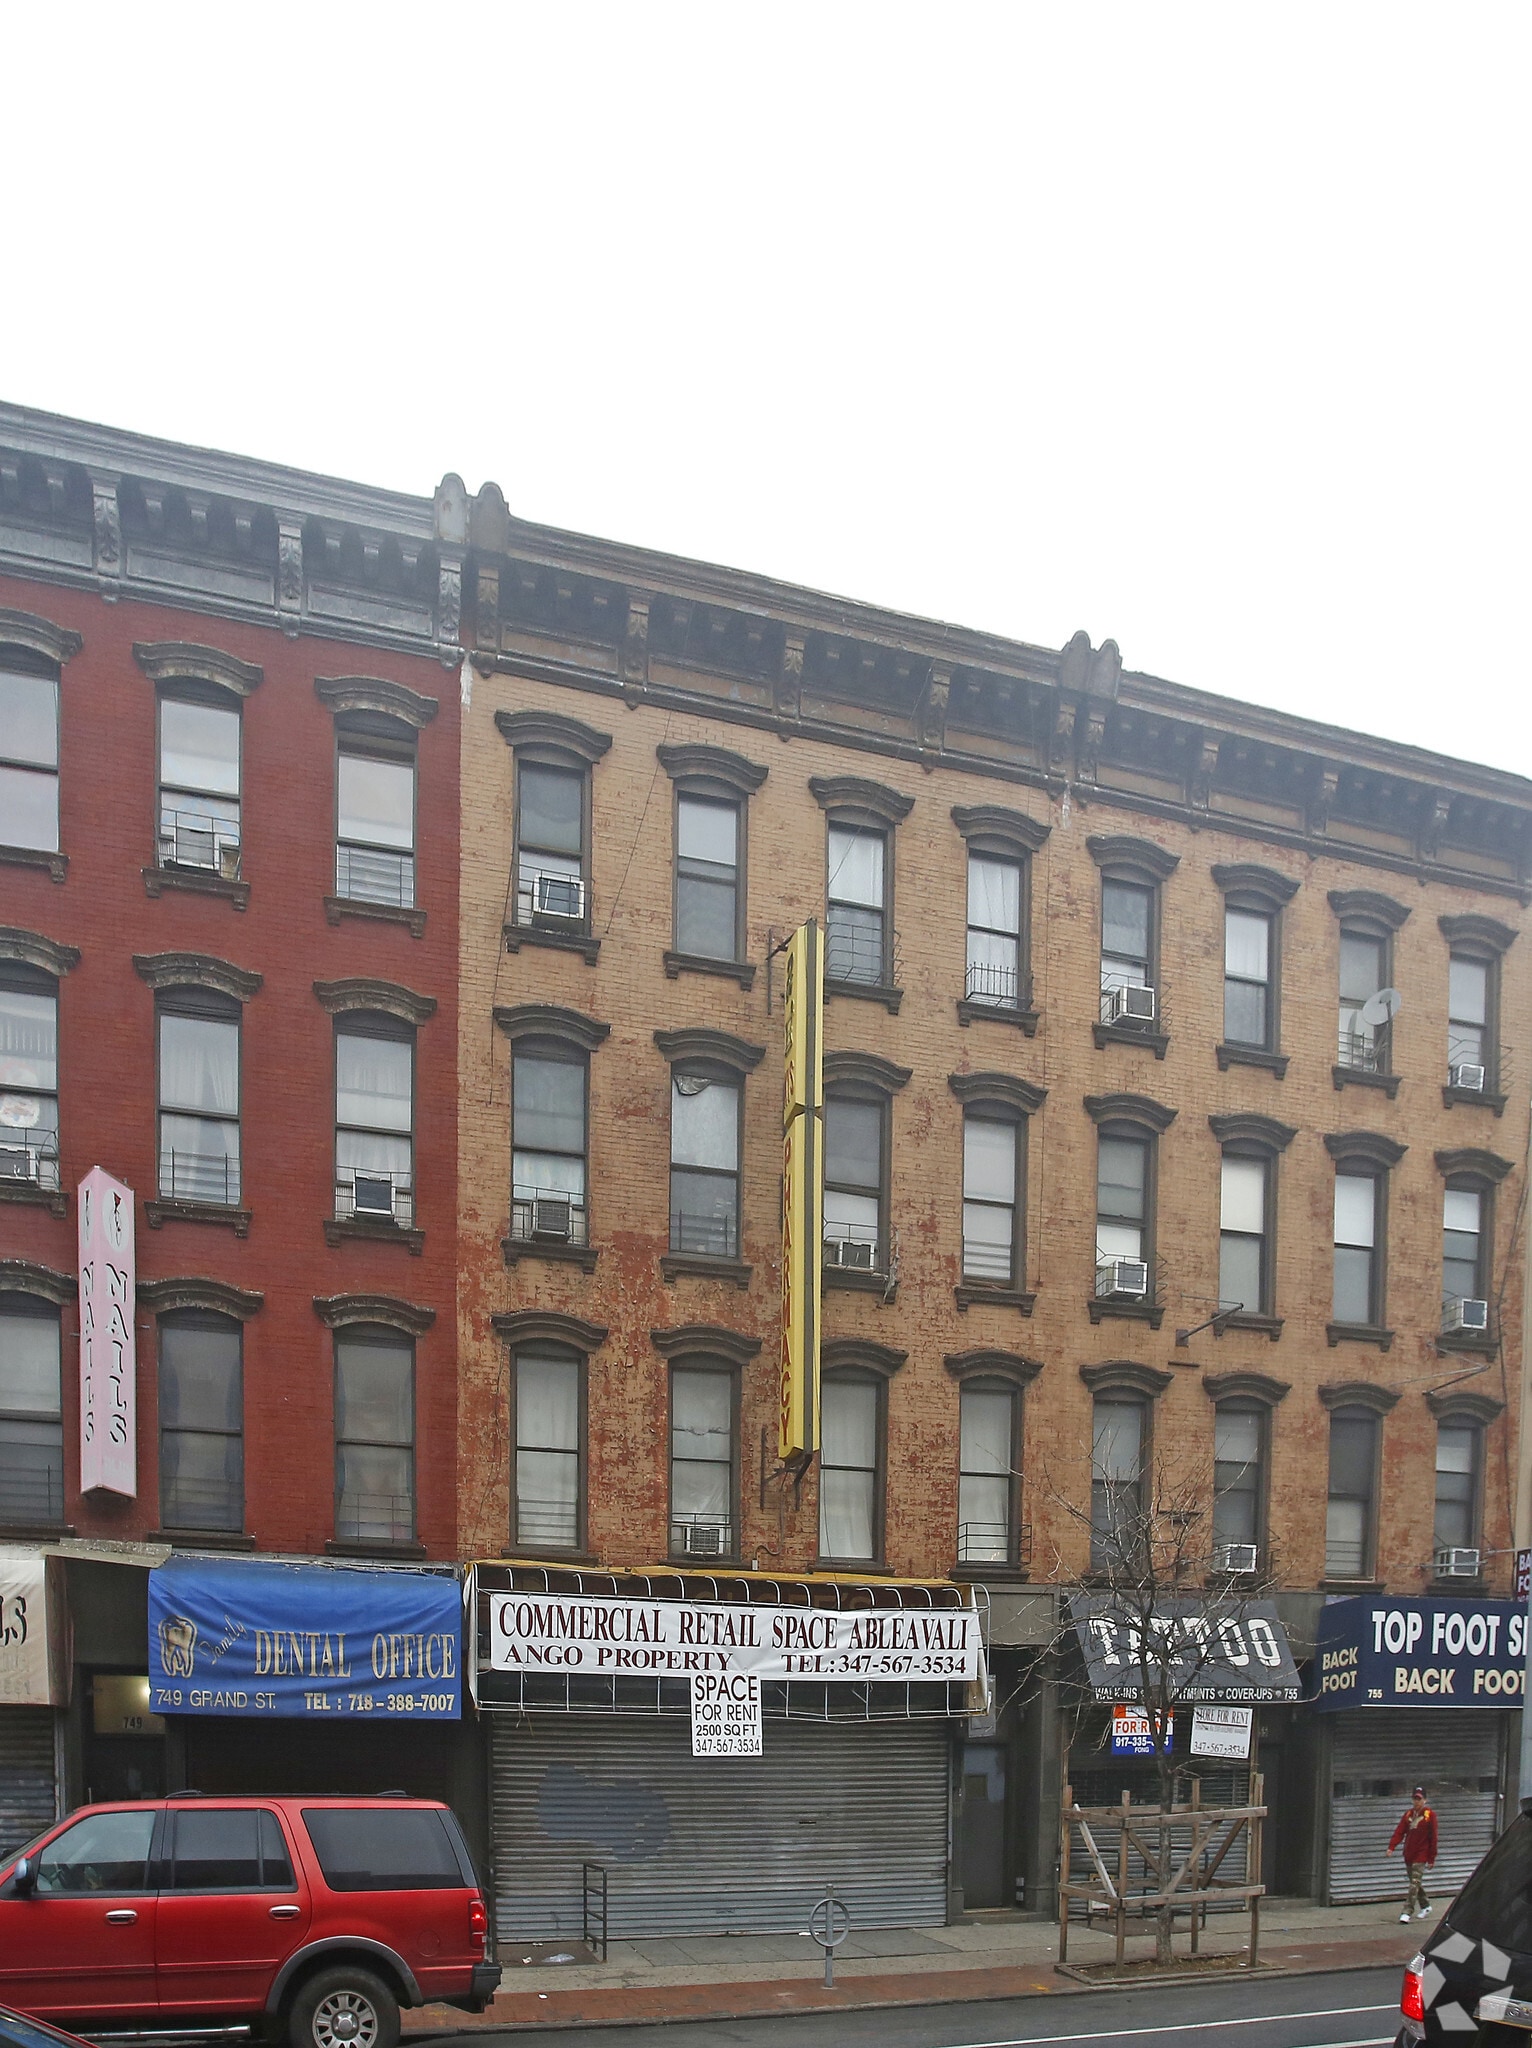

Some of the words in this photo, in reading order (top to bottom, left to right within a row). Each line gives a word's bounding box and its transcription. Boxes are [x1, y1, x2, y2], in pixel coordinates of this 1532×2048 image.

[781, 1136, 792, 1446] PHARMACY
[105, 1262, 129, 1443] NAILS
[499, 1602, 667, 1643] COMMERCIAL
[679, 1610, 761, 1647] RETAIL
[772, 1615, 837, 1649] SPACE
[848, 1617, 968, 1650] ABLEAVALI
[1372, 1610, 1423, 1654] TOP
[1431, 1612, 1500, 1656] FOOT
[199, 1614, 247, 1665] Family
[254, 1630, 351, 1678] DENTAL
[371, 1633, 456, 1679] OFFICE
[504, 1644, 583, 1665] ANGO
[597, 1648, 733, 1671] PROPERTY
[1322, 1647, 1358, 1670] BACK
[695, 1675, 757, 1701] SPACE
[1322, 1671, 1357, 1693] FOOT
[1394, 1667, 1455, 1694] BACK
[156, 1689, 182, 1706] 749
[190, 1690, 248, 1708] GRAND
[255, 1693, 276, 1709] ST.
[1226, 1688, 1272, 1700] COVER-UPS
[1285, 1688, 1298, 1700] 755
[1368, 1689, 1382, 1699] 755
[124, 1717, 142, 1729] 749
[695, 1704, 721, 1721] FOR
[727, 1704, 757, 1721] RENT
[1217, 1709, 1229, 1722] FOR
[1232, 1711, 1249, 1724] RENT
[696, 1724, 721, 1736] 2500
[724, 1724, 741, 1736] SQ
[1116, 1721, 1136, 1733] FOR
[696, 1738, 759, 1752] 347-567-3534
